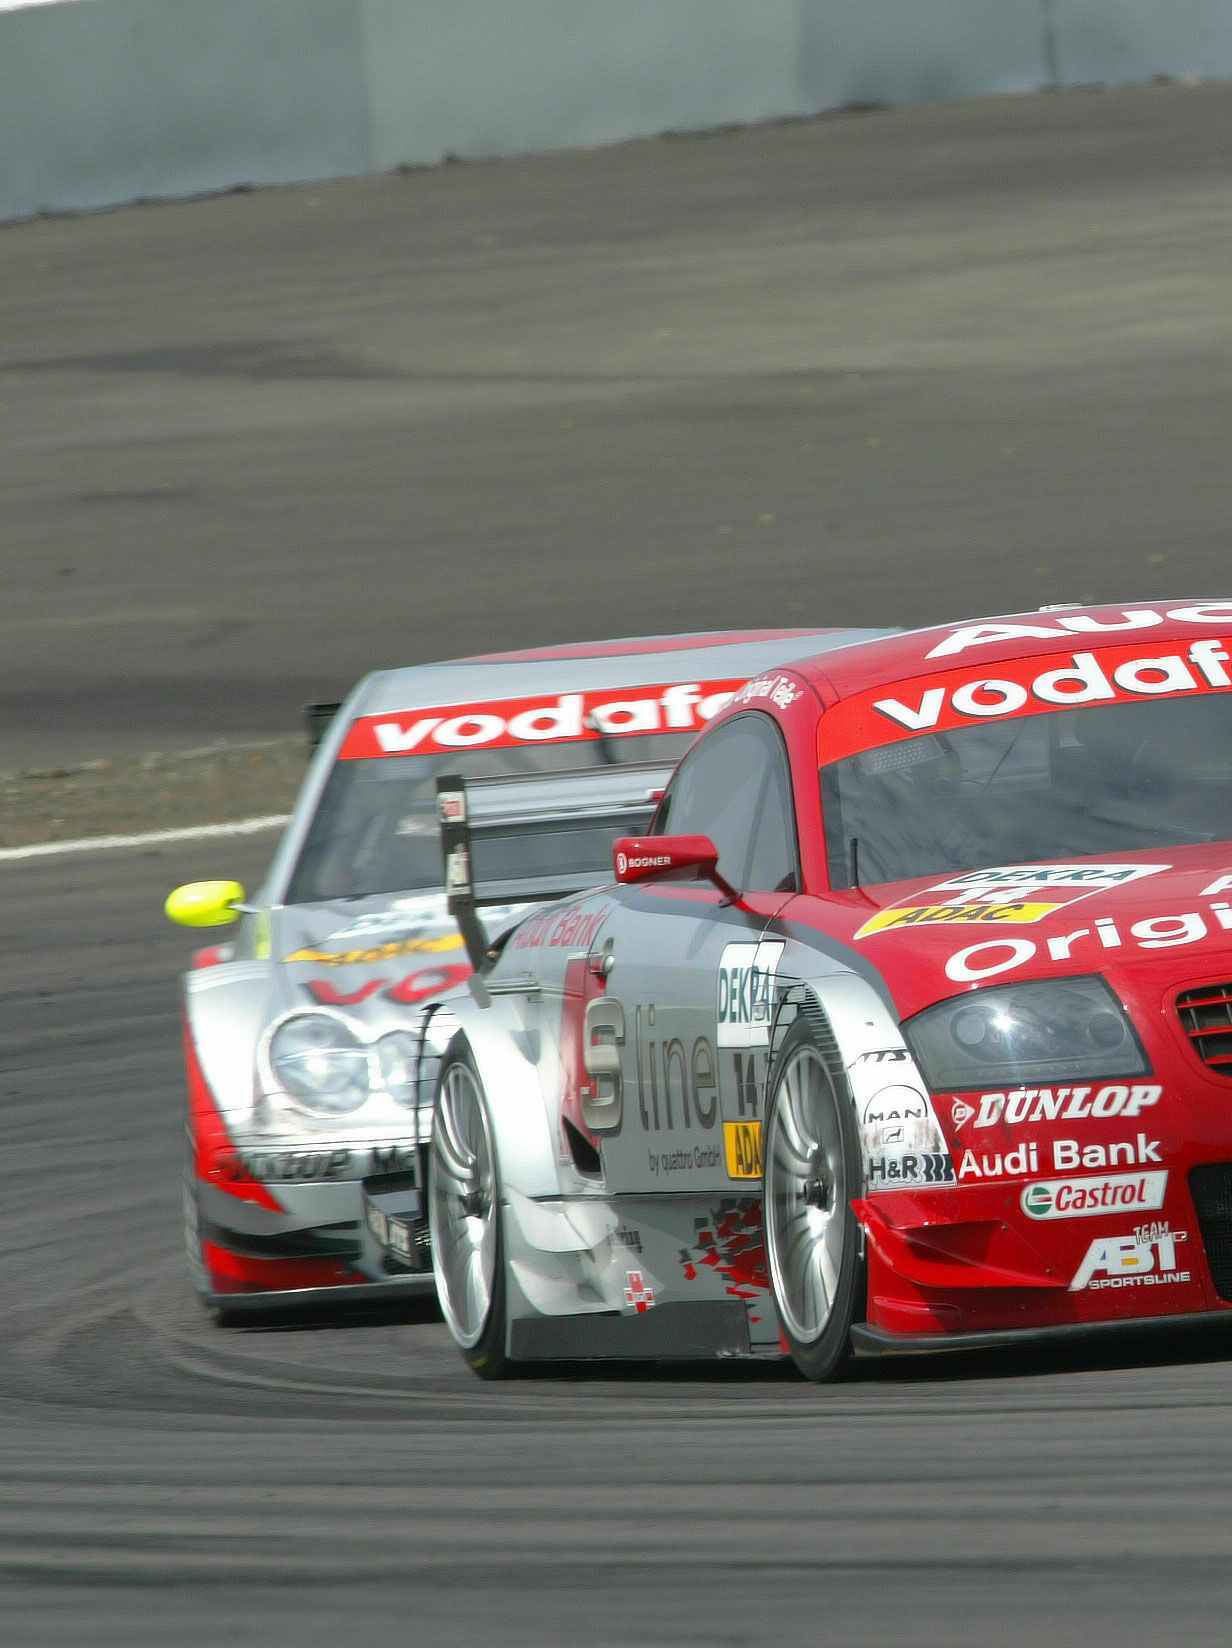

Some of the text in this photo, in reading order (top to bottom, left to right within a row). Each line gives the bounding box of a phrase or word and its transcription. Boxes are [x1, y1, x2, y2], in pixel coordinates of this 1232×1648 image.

[628, 856, 672, 868] BOGNER
[947, 869, 1138, 885] DEKRA
[886, 903, 1024, 927] ADAC
[719, 964, 775, 1024] DEKRA
[635, 1003, 717, 1132] line
[868, 1108, 922, 1124] MAN
[972, 1084, 1163, 1129] DUNLOP
[868, 1155, 918, 1181] H&R
[957, 1133, 1163, 1179] Audi Bank
[1055, 1177, 1147, 1212] Castrol
[1133, 1220, 1170, 1246] TEAM
[1067, 1232, 1178, 1292] ABT
[1088, 1271, 1192, 1290] SPORTSLINE
